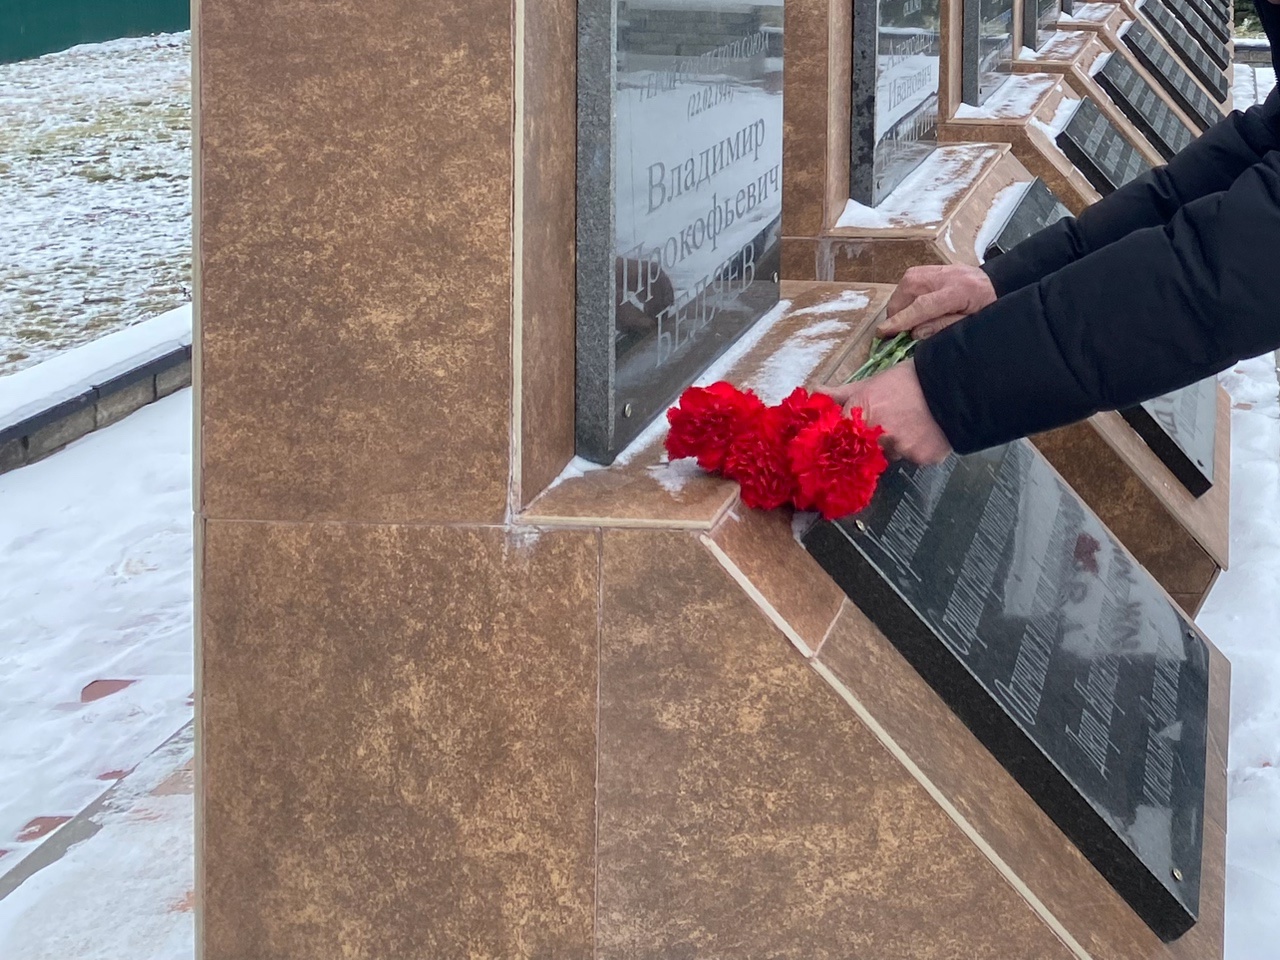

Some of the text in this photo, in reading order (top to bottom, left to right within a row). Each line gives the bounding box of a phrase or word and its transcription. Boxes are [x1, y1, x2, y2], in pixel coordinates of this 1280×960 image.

[888, 64, 933, 112] Иванович
[644, 117, 766, 217] Владимир
[619, 163, 780, 307] Прокофьевич
[655, 239, 757, 369] БЕЛЯЕВ
